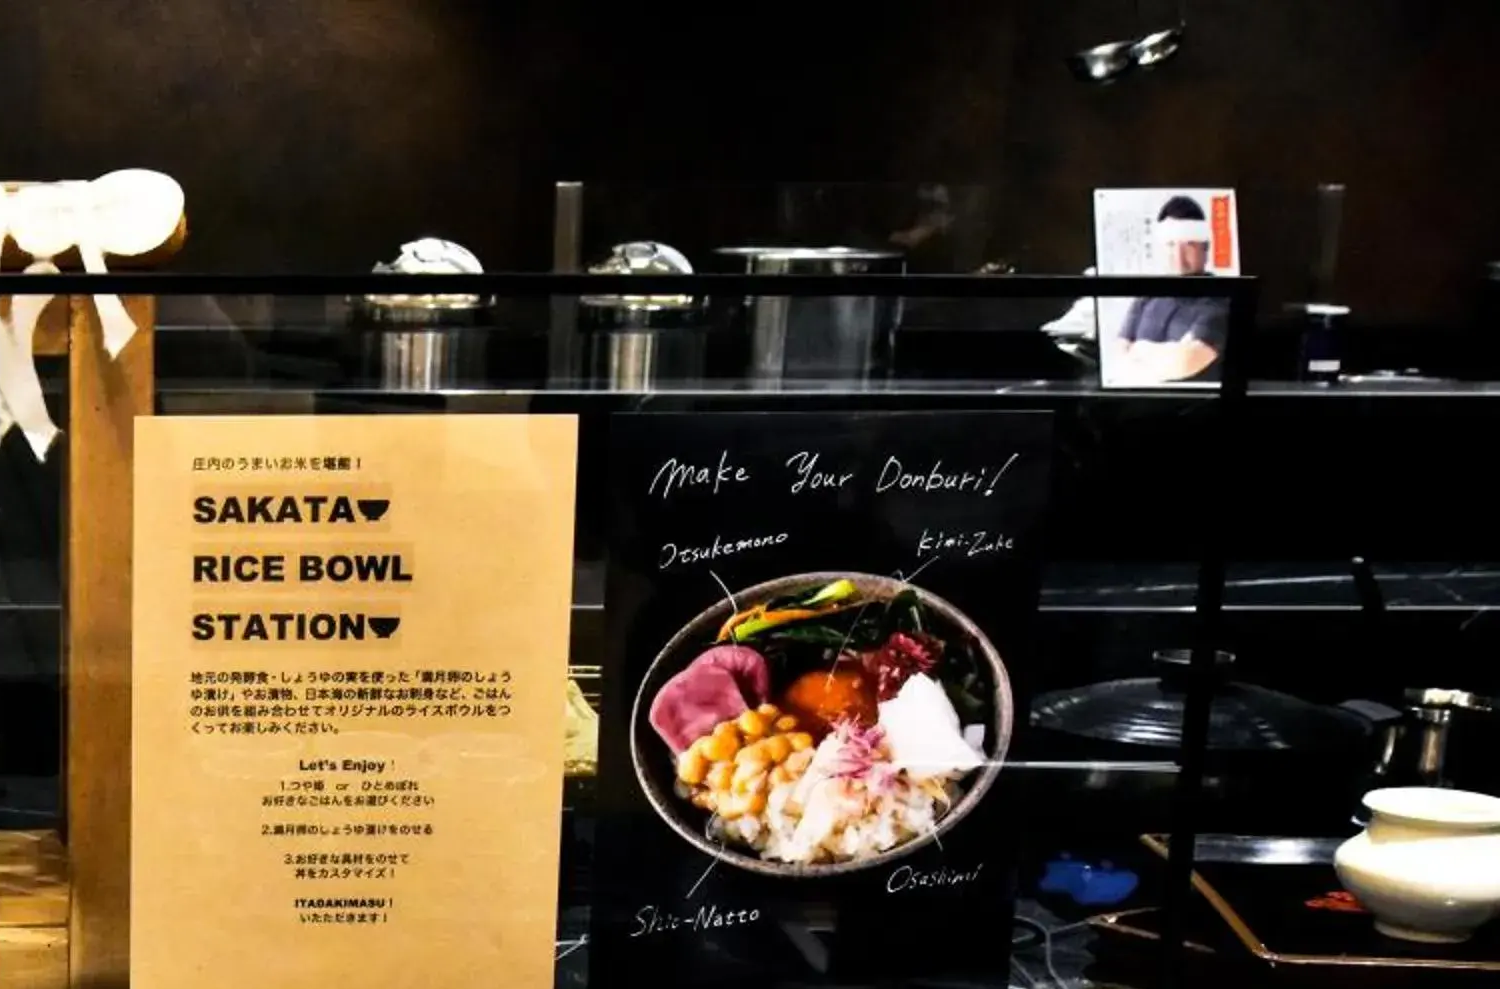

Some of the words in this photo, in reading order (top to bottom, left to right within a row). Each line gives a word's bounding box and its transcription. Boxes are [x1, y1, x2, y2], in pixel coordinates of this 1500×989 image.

[649, 450, 751, 499] Make
[785, 451, 853, 494] Your
[875, 453, 1019, 496] Donburi!
[192, 495, 356, 525] SAKATA
[192, 555, 285, 583] RICE
[299, 555, 413, 583] BOWL
[191, 613, 367, 641] STATION
[298, 759, 338, 772] Let's
[335, 782, 350, 791] or
